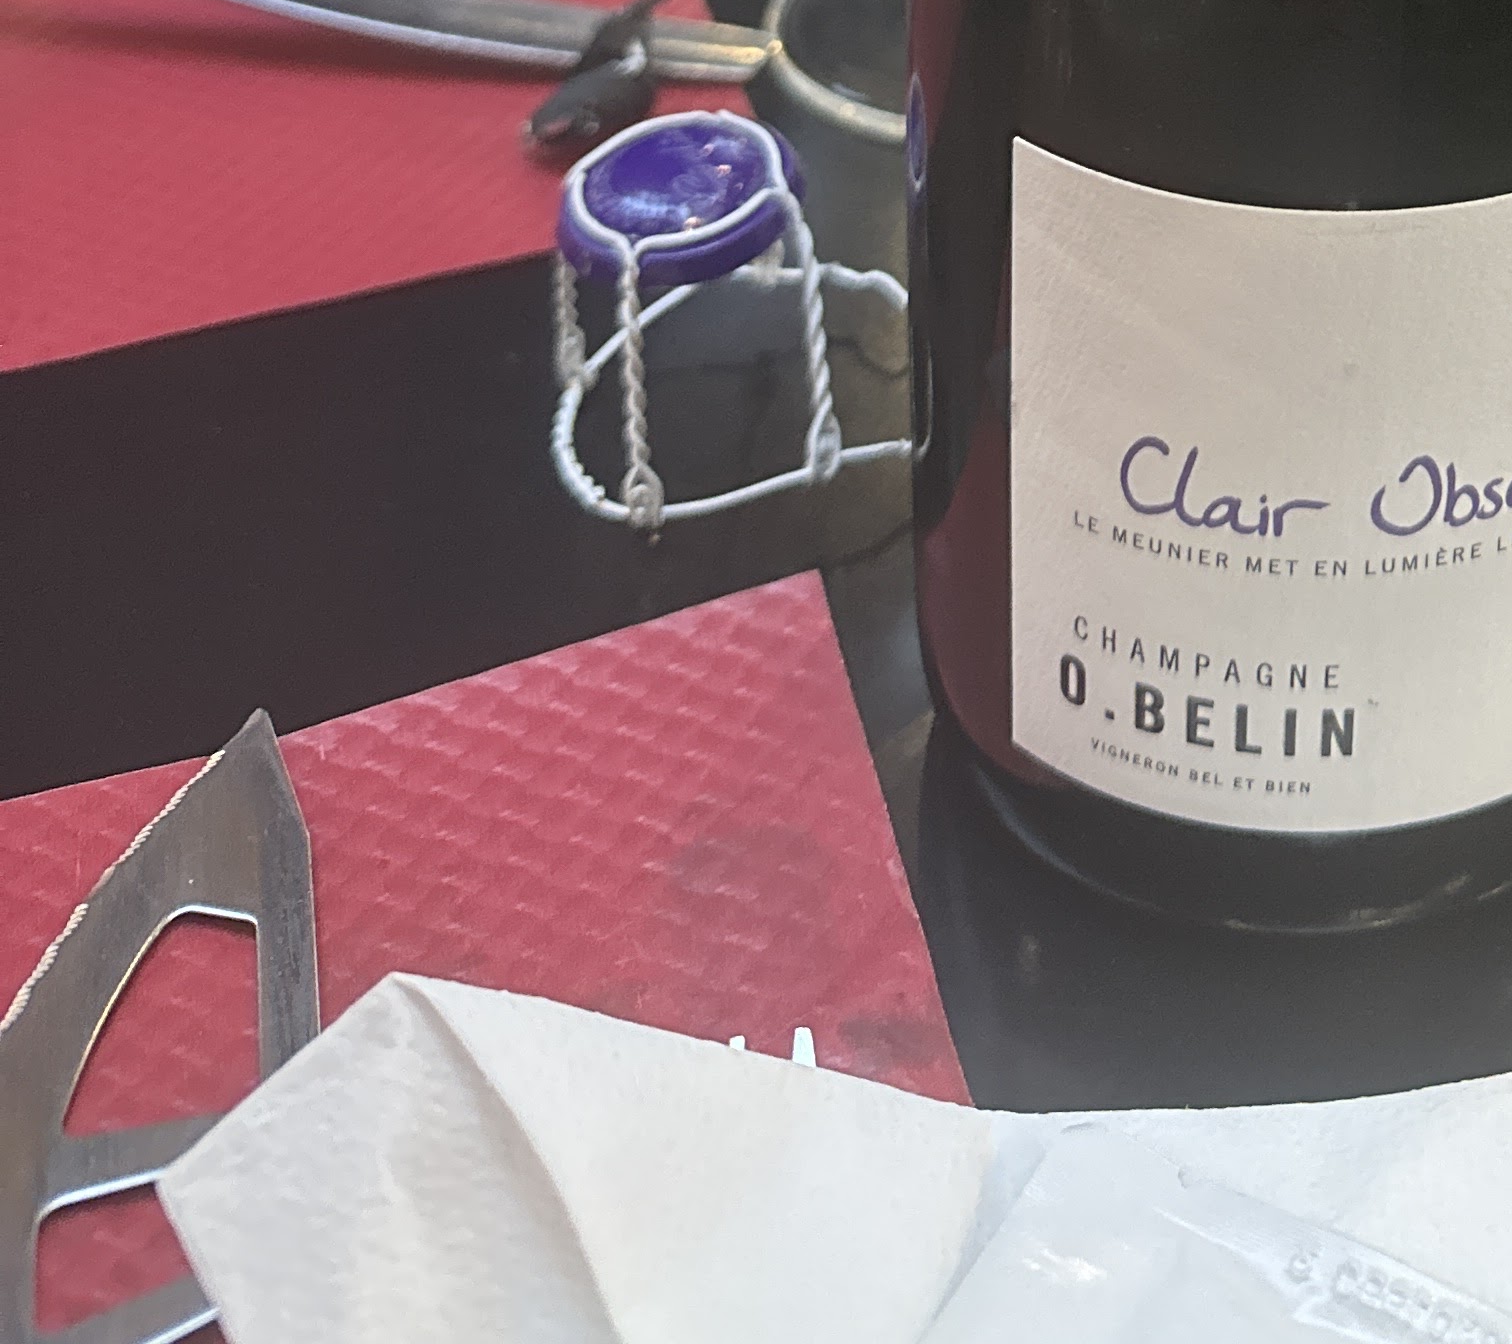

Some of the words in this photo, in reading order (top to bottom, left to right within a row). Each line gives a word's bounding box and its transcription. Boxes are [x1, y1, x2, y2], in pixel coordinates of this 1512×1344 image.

[1119, 435, 1330, 538] Clair
[1073, 508, 1101, 534] LE
[1111, 524, 1230, 570] MEUNIER
[1245, 555, 1299, 577] MET
[1314, 559, 1348, 577] EN
[1364, 544, 1483, 576] LUMIÈRE
[1073, 614, 1343, 691] CHAMPAGNE
[1058, 652, 1358, 758] O.BELIN
[1090, 736, 1180, 779] VIGNERON
[1188, 769, 1224, 788] BEL
[1233, 776, 1255, 792] ET
[1265, 779, 1311, 794] BIEN
